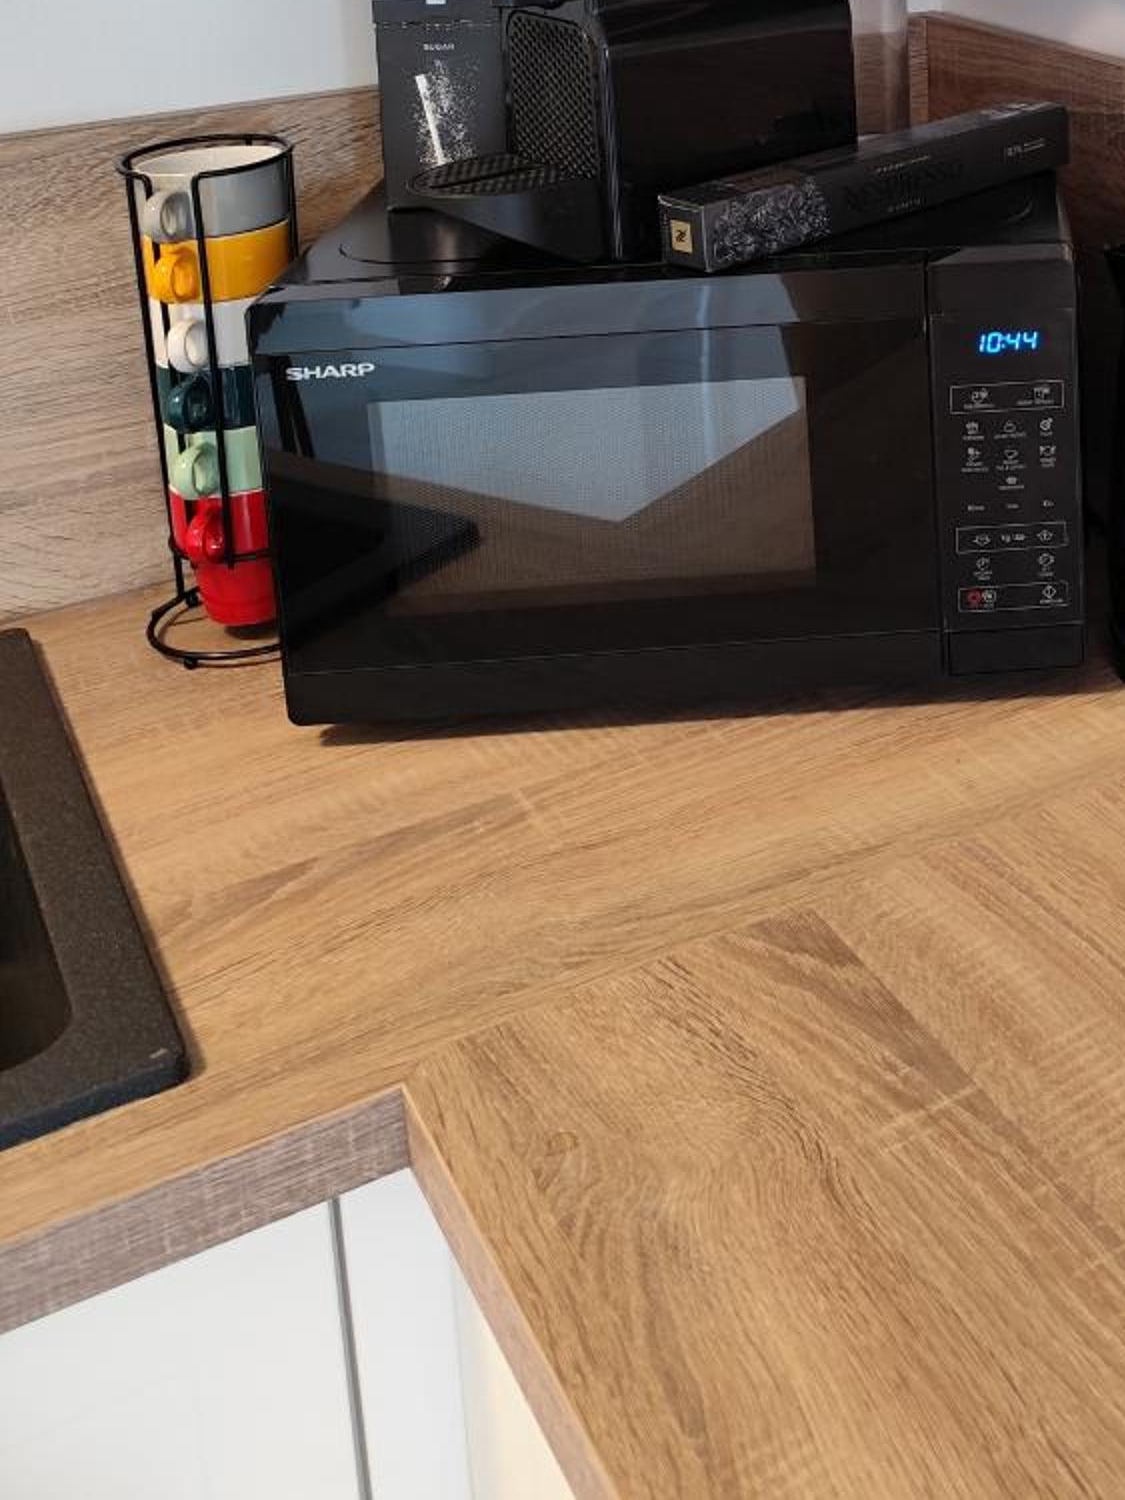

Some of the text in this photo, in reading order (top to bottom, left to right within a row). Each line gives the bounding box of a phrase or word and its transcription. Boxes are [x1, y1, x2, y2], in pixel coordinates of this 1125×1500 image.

[423, 43, 455, 51] SUGAR
[979, 331, 1039, 353] 10:44
[286, 362, 376, 381] SHARP
